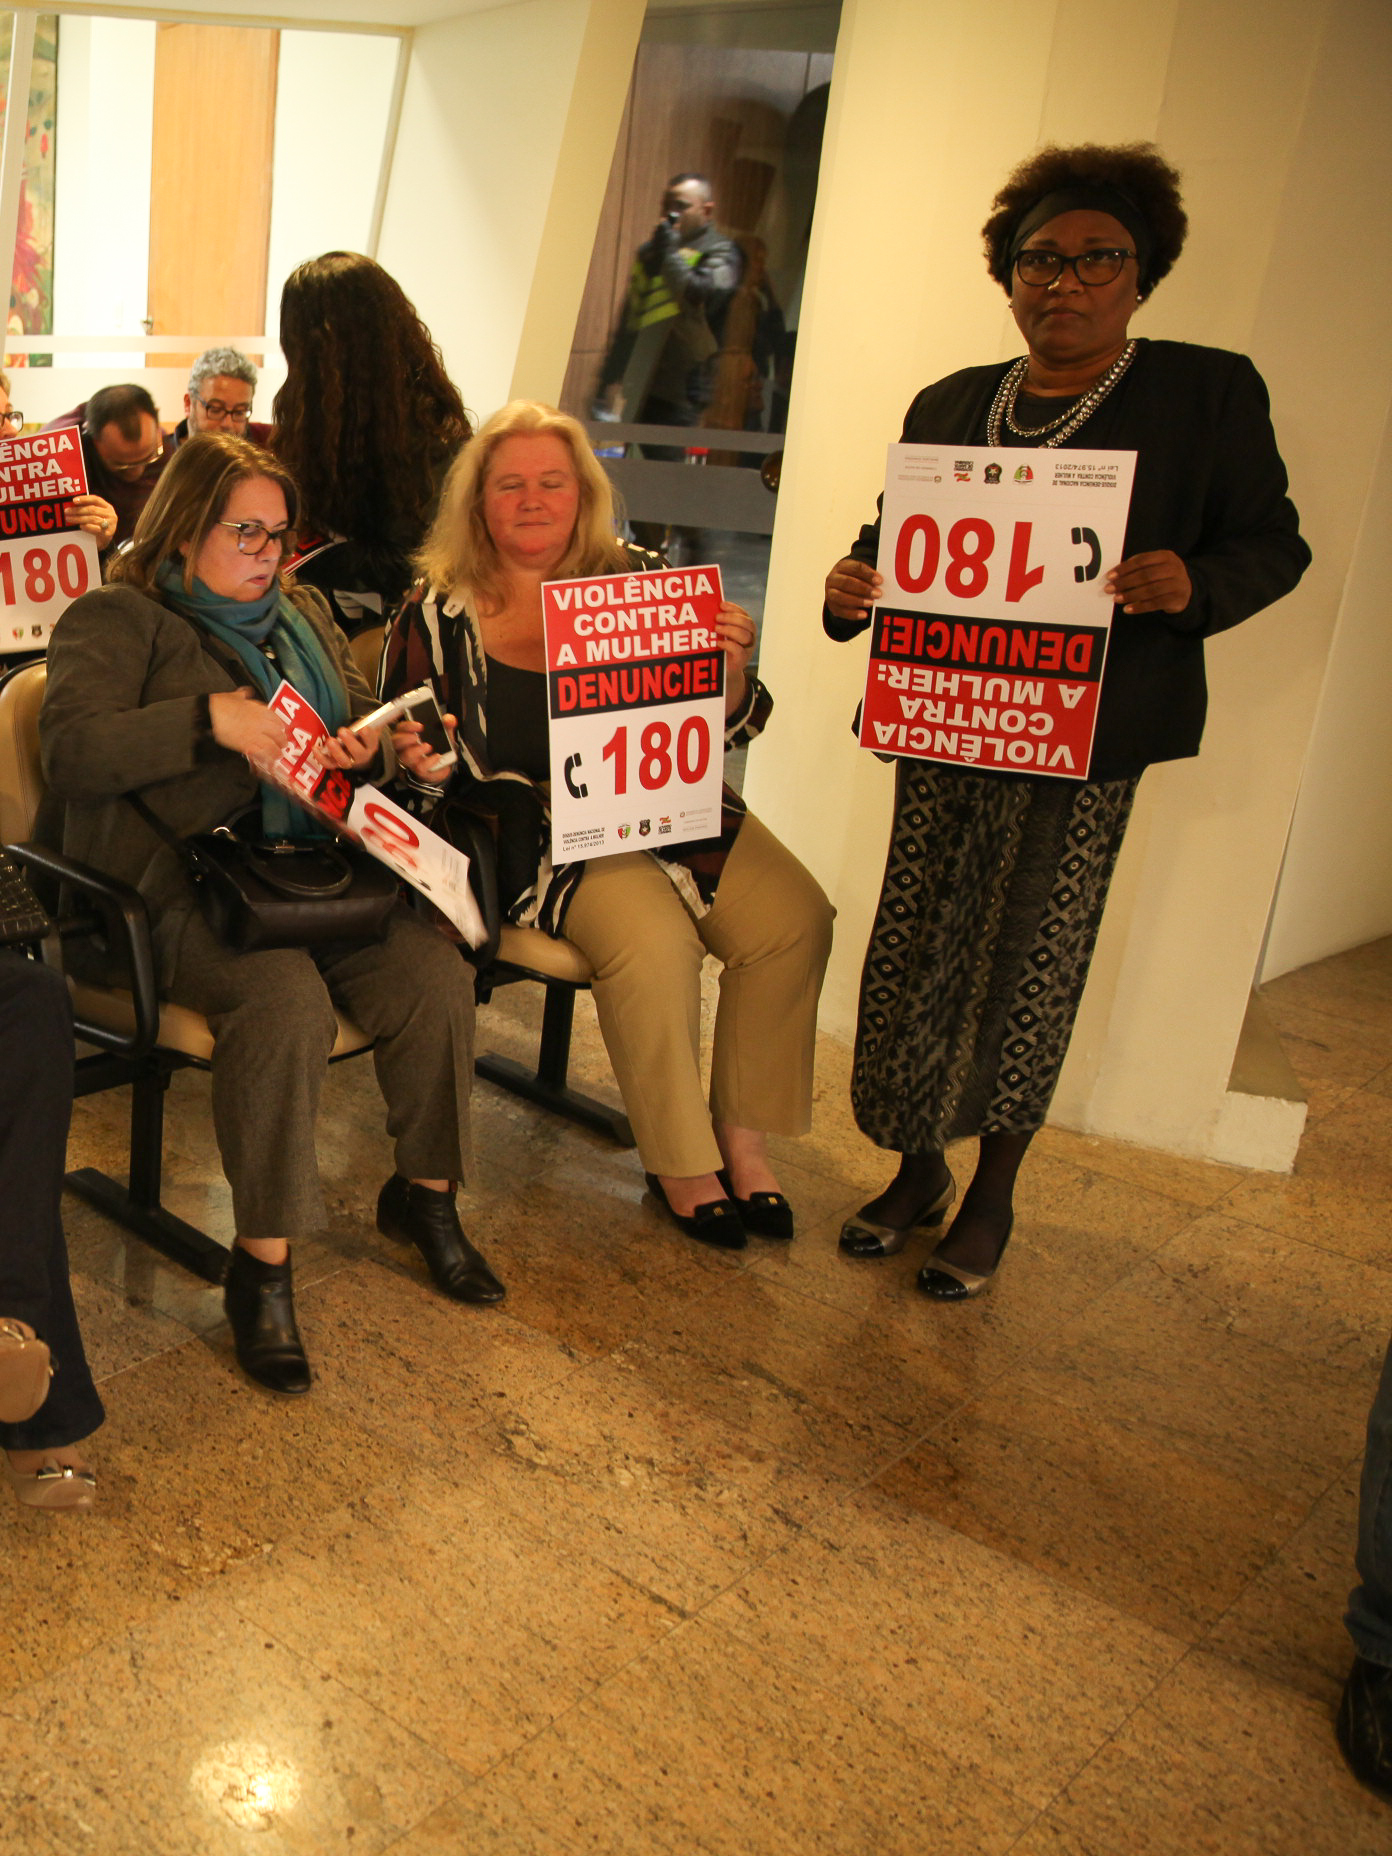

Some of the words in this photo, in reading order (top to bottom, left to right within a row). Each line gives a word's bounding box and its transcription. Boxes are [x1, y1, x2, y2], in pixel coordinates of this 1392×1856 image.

[895, 514, 1045, 603] 180
[552, 574, 714, 611] VIOLÊNCIA
[573, 603, 698, 636] CONTRA
[556, 643, 578, 666] A
[586, 627, 717, 663] MULHER:
[880, 615, 1094, 673] DENUNCIE!
[558, 658, 719, 711] DENUNCIE!
[877, 664, 1044, 705] MULHER:
[1058, 683, 1087, 709] A
[898, 695, 1054, 736] CONTRA
[602, 715, 710, 795] 180
[872, 721, 1076, 769] VIOLÊNCIA
